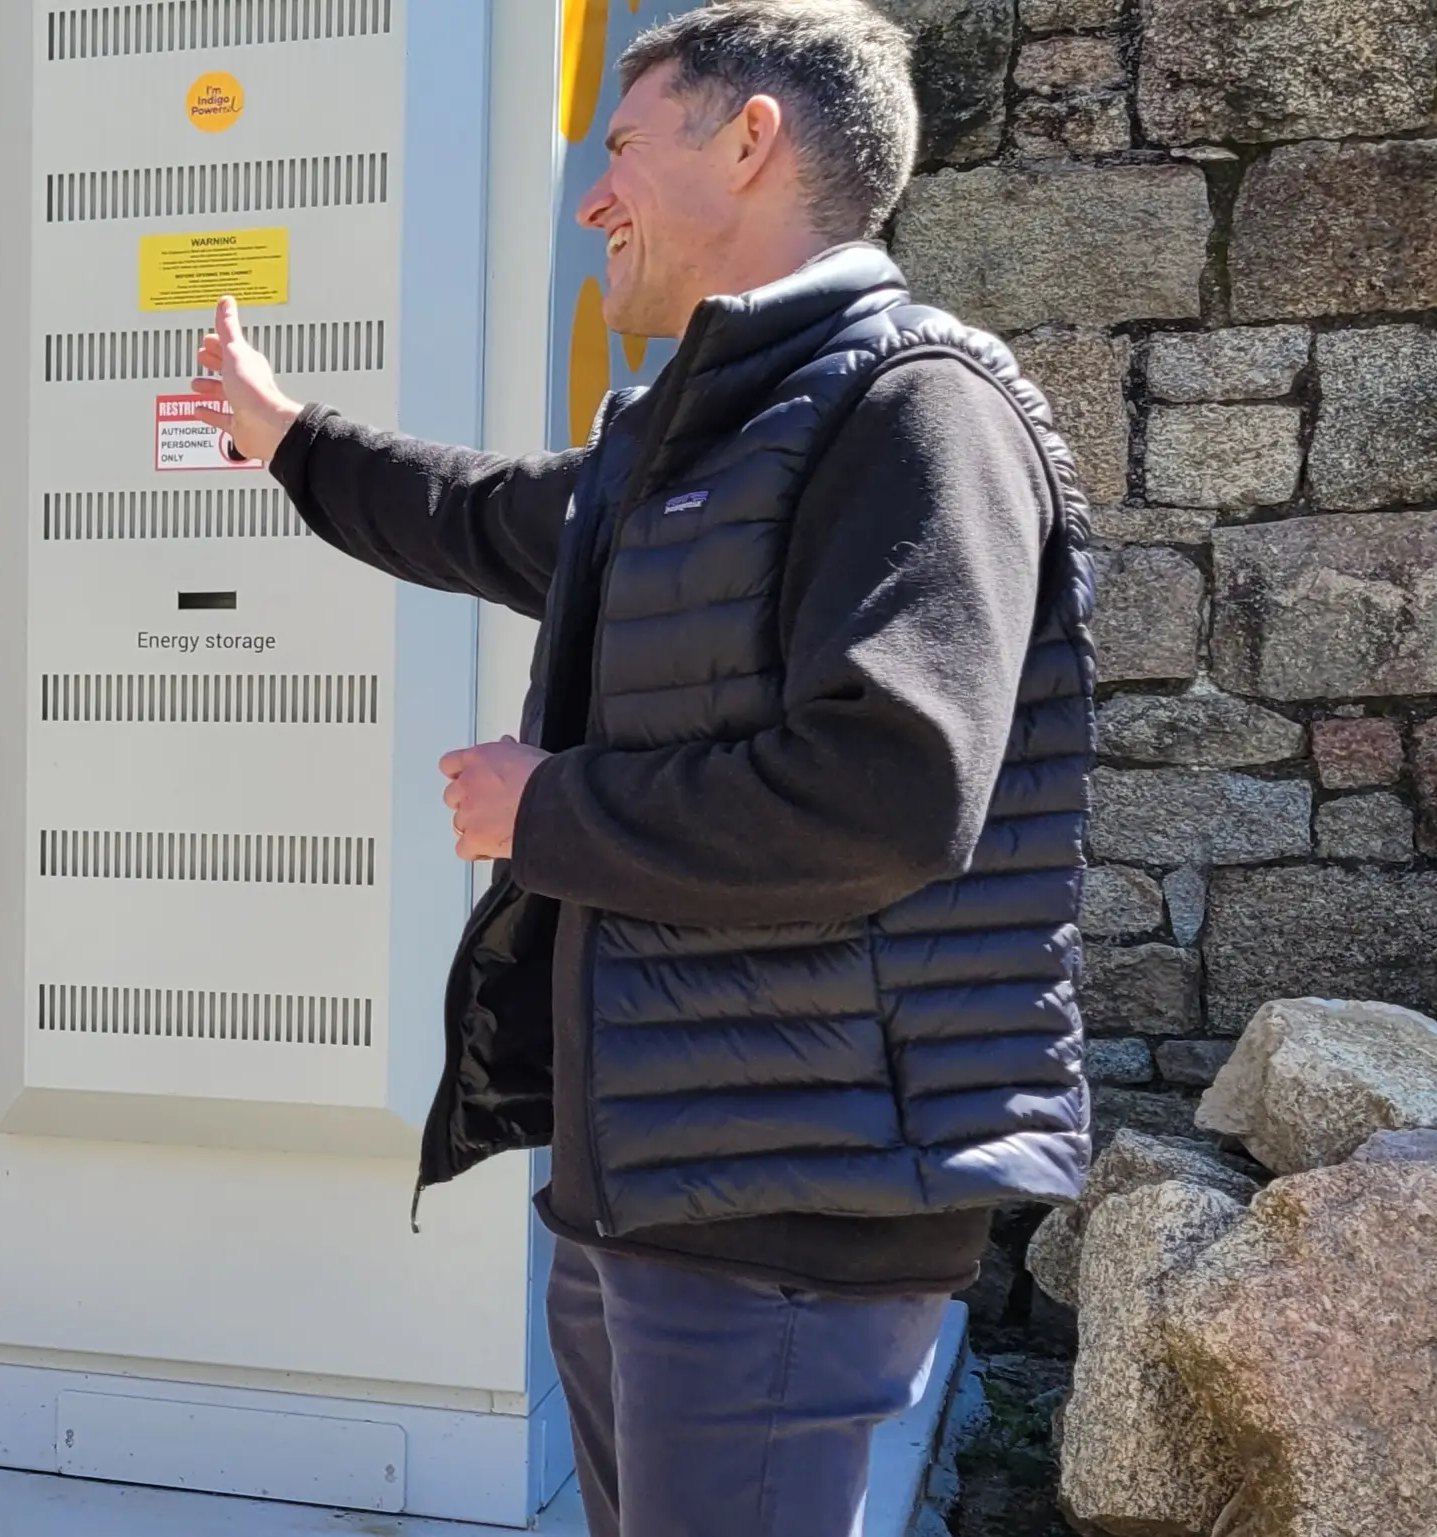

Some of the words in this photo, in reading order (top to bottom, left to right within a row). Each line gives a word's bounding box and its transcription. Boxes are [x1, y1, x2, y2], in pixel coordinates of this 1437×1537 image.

[206, 85, 222, 96] I'm
[197, 96, 230, 106] Indigo
[191, 236, 237, 247] WARNING
[161, 427, 217, 436] AUTHORIZED
[161, 440, 214, 449] PERSONNEL
[161, 454, 184, 462] ONLY
[137, 631, 200, 653] Energy
[205, 633, 276, 654] storage
